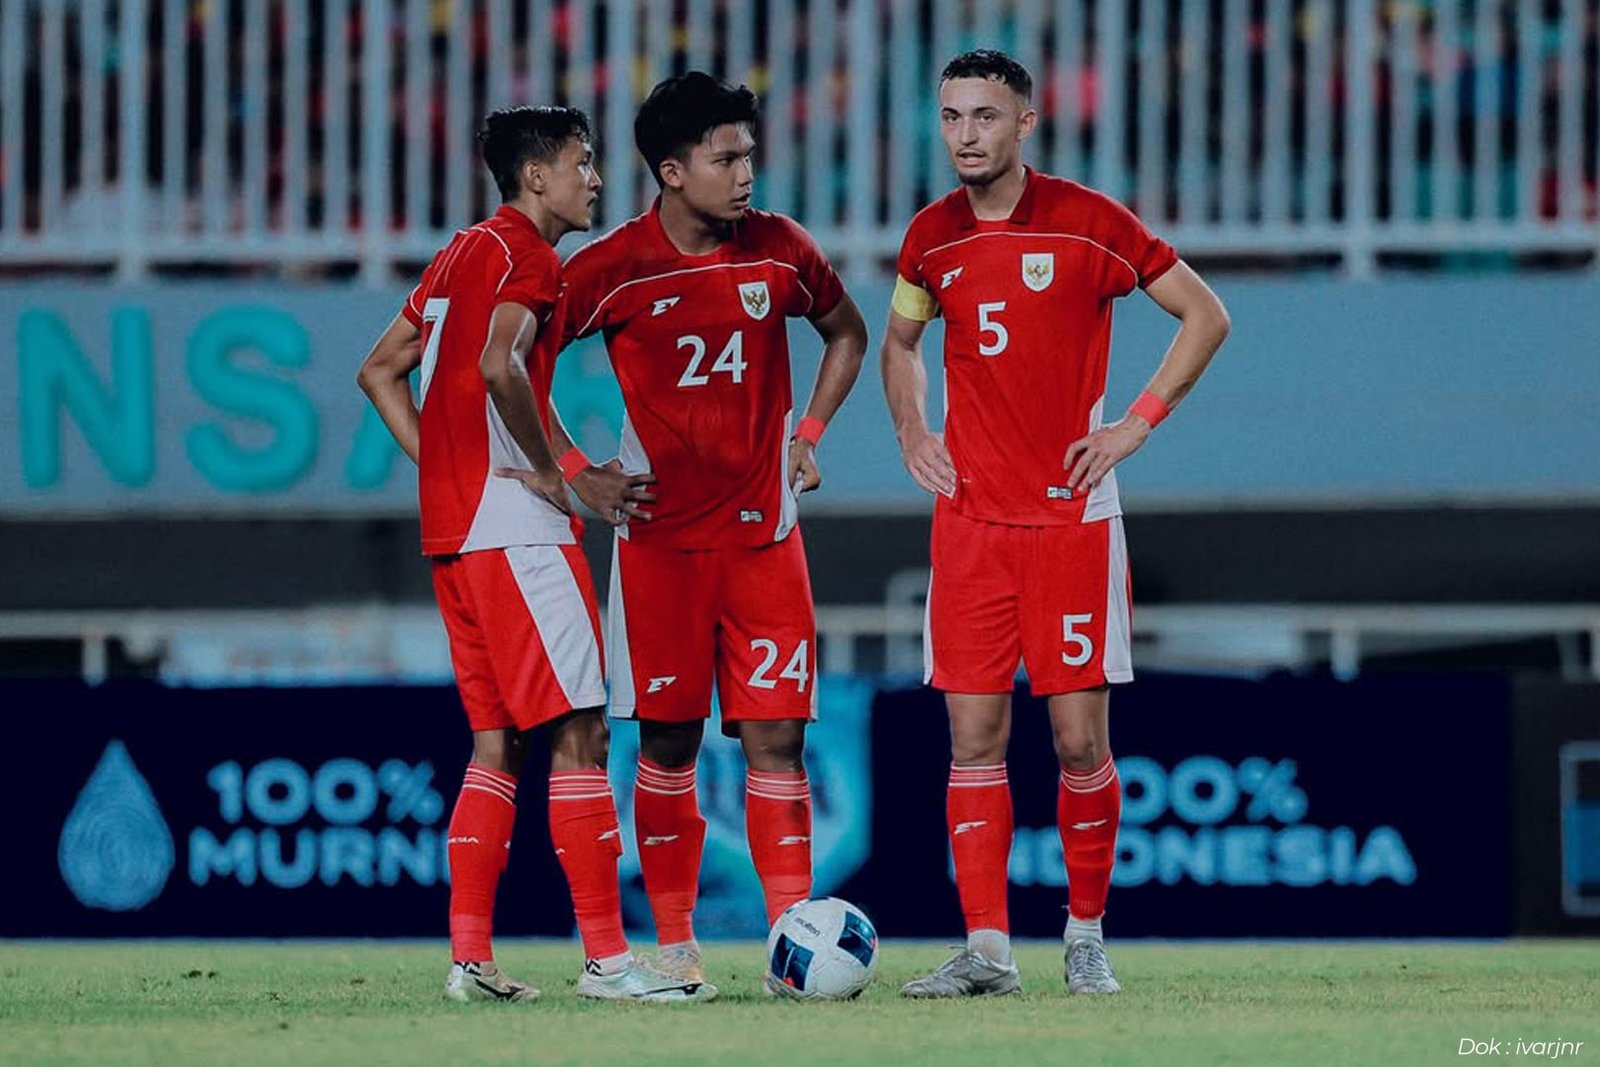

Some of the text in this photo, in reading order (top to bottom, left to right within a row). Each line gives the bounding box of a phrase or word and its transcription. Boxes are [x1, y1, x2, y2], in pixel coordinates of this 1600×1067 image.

[420, 297, 450, 412] 7
[977, 301, 1008, 356] 5
[677, 331, 747, 387] 24
[748, 638, 809, 692] 24
[1062, 613, 1093, 666] 5
[208, 757, 443, 824] 100%
[1118, 756, 1308, 824] 00%
